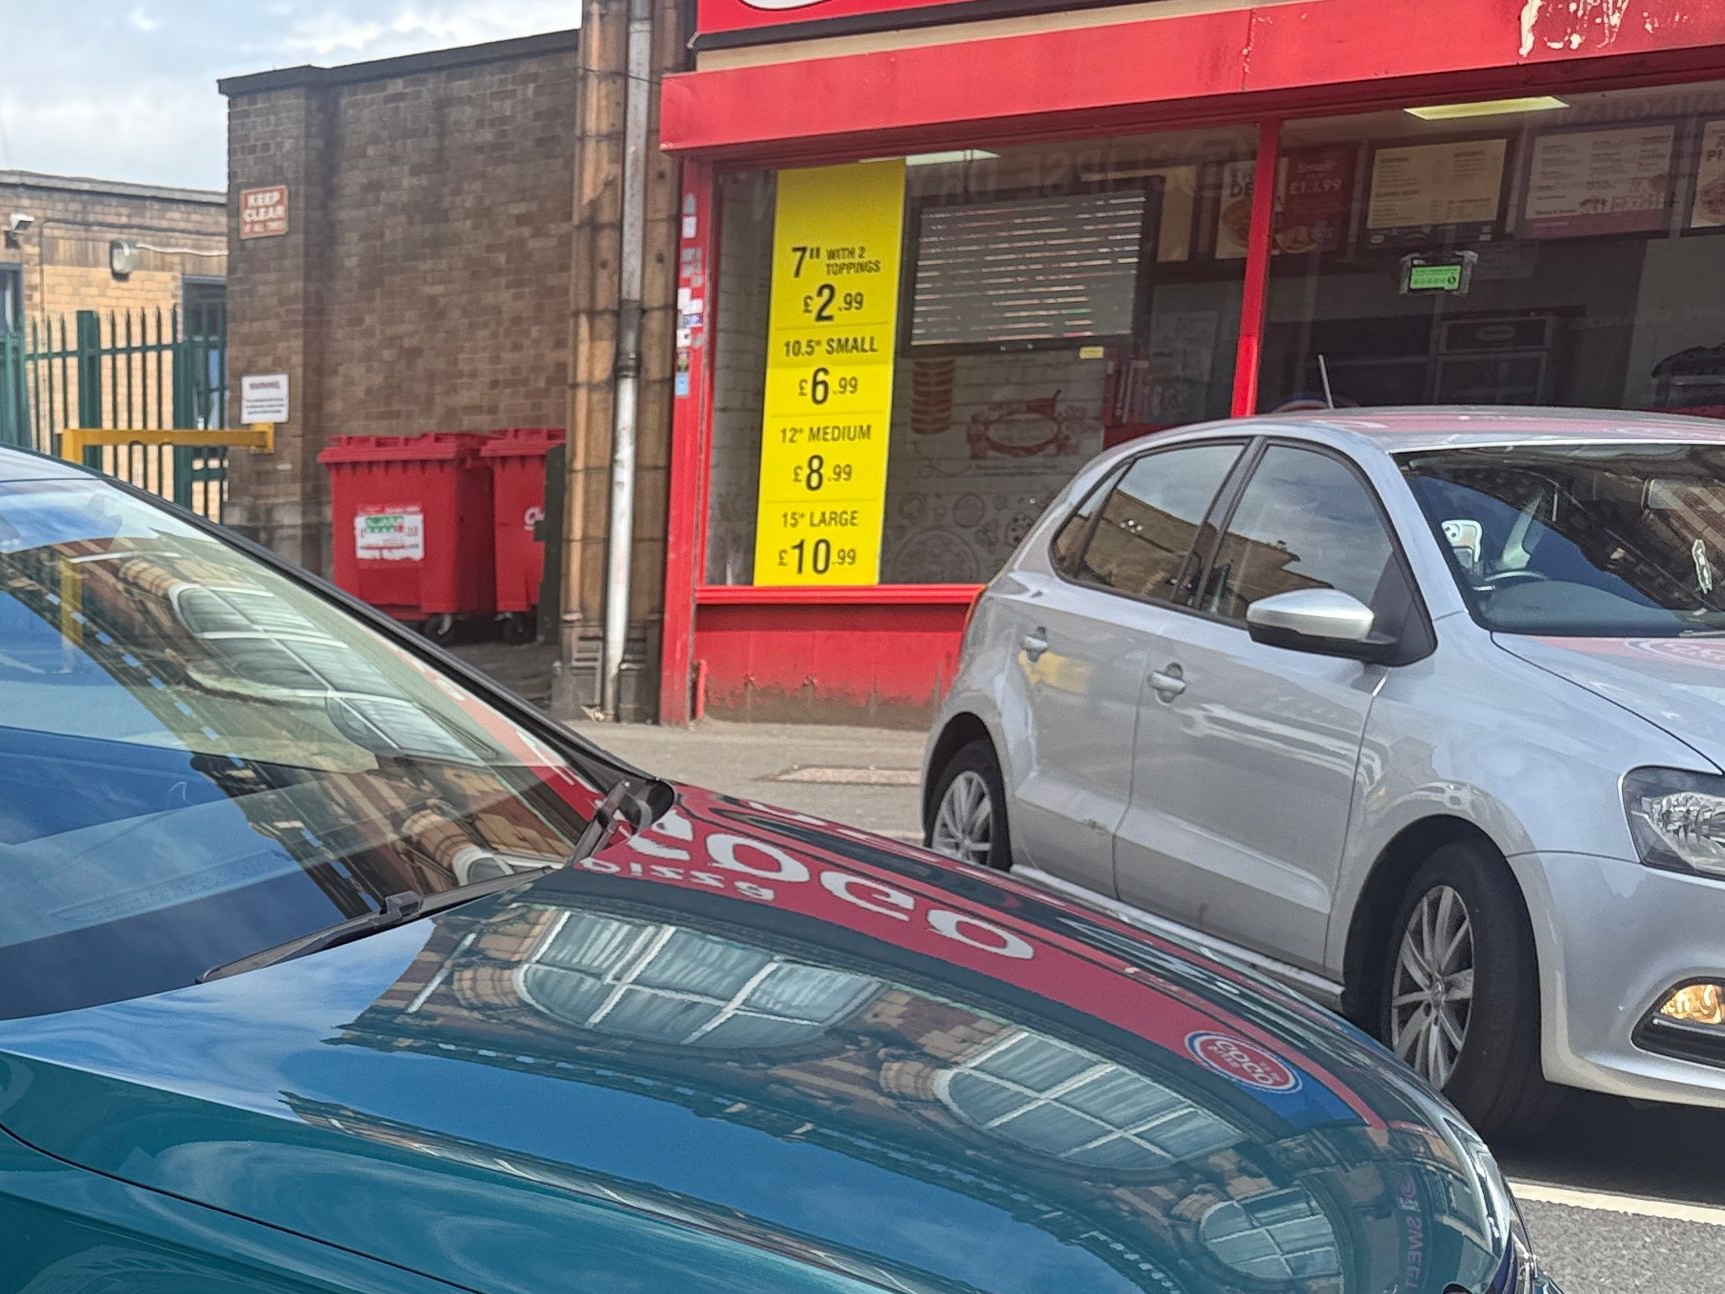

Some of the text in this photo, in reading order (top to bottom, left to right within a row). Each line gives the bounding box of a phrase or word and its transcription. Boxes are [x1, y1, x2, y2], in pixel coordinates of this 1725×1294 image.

[826, 247, 856, 260] WITH
[858, 246, 867, 258] 2
[825, 260, 881, 276] TOPPINGS
[825, 336, 878, 355] SMALL
[807, 424, 872, 442] MEDIUM
[809, 510, 859, 527] LARGE
